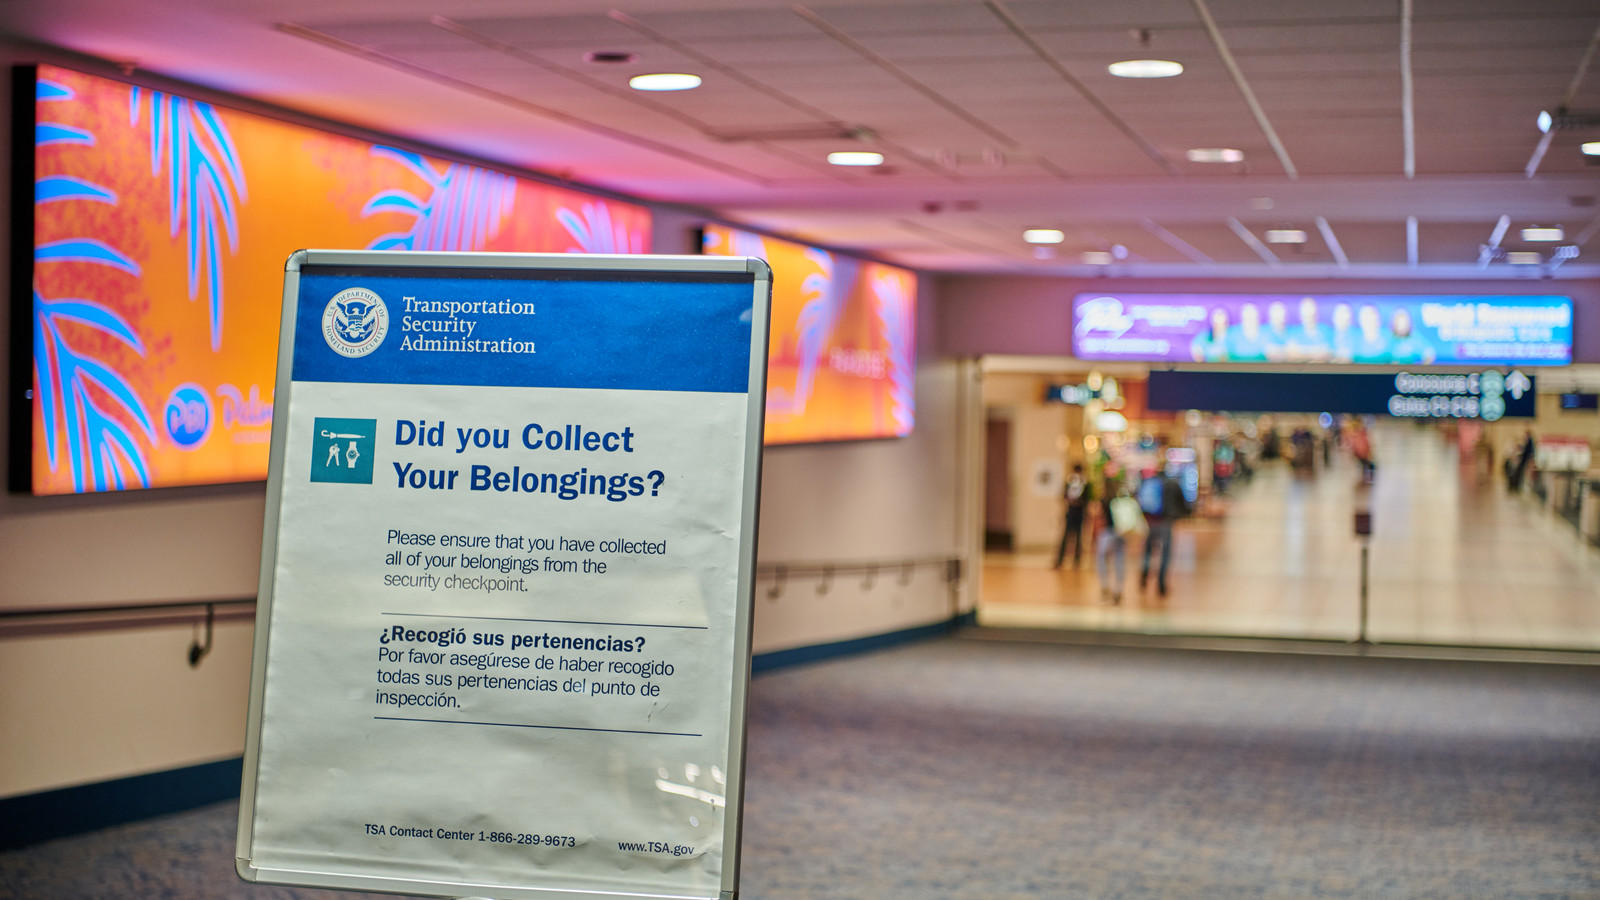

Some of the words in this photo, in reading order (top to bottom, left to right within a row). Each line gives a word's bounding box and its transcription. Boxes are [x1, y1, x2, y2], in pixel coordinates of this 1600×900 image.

[338, 291, 380, 310] DEPARTMENT
[403, 296, 535, 316] Transportation
[402, 315, 476, 337] Security
[326, 325, 356, 354] HOMELAND
[357, 326, 385, 354] SECURITY
[400, 335, 536, 353] Administration
[396, 420, 444, 446] Did
[456, 428, 509, 453] you
[522, 423, 634, 452] Collect
[393, 462, 458, 489] Your
[471, 465, 664, 502] Belongings?
[388, 530, 435, 546] Please
[441, 535, 490, 548] ensure
[495, 534, 524, 549] that
[528, 539, 554, 553] you
[560, 536, 594, 552] have
[600, 538, 666, 554] collected
[386, 551, 401, 565] all
[407, 552, 422, 566] of
[424, 556, 457, 570] your
[461, 554, 539, 574] belongings
[544, 557, 577, 572] from
[583, 559, 606, 573] the
[384, 573, 440, 591] security
[445, 574, 528, 593] checkpoint.
[380, 626, 466, 647] ¿Recogió
[473, 633, 504, 646] sus
[512, 633, 645, 652] pertenencias?
[379, 647, 404, 662] Por
[408, 649, 446, 664] favor
[450, 651, 530, 670] asegúrese
[535, 655, 554, 670] de
[560, 656, 604, 672] haber
[609, 660, 674, 678] recogido
[377, 669, 419, 684] todas
[425, 674, 452, 686] sus
[458, 675, 557, 692] pertenencias
[563, 678, 585, 692] del
[591, 681, 635, 696] punto
[641, 682, 660, 696] de
[376, 689, 460, 708] inspección.
[365, 824, 385, 835] TSA
[390, 826, 433, 838] Contact
[437, 829, 474, 840] Center
[478, 830, 576, 848] 1-866-289-9673
[618, 842, 694, 857] www.TSA.gov
